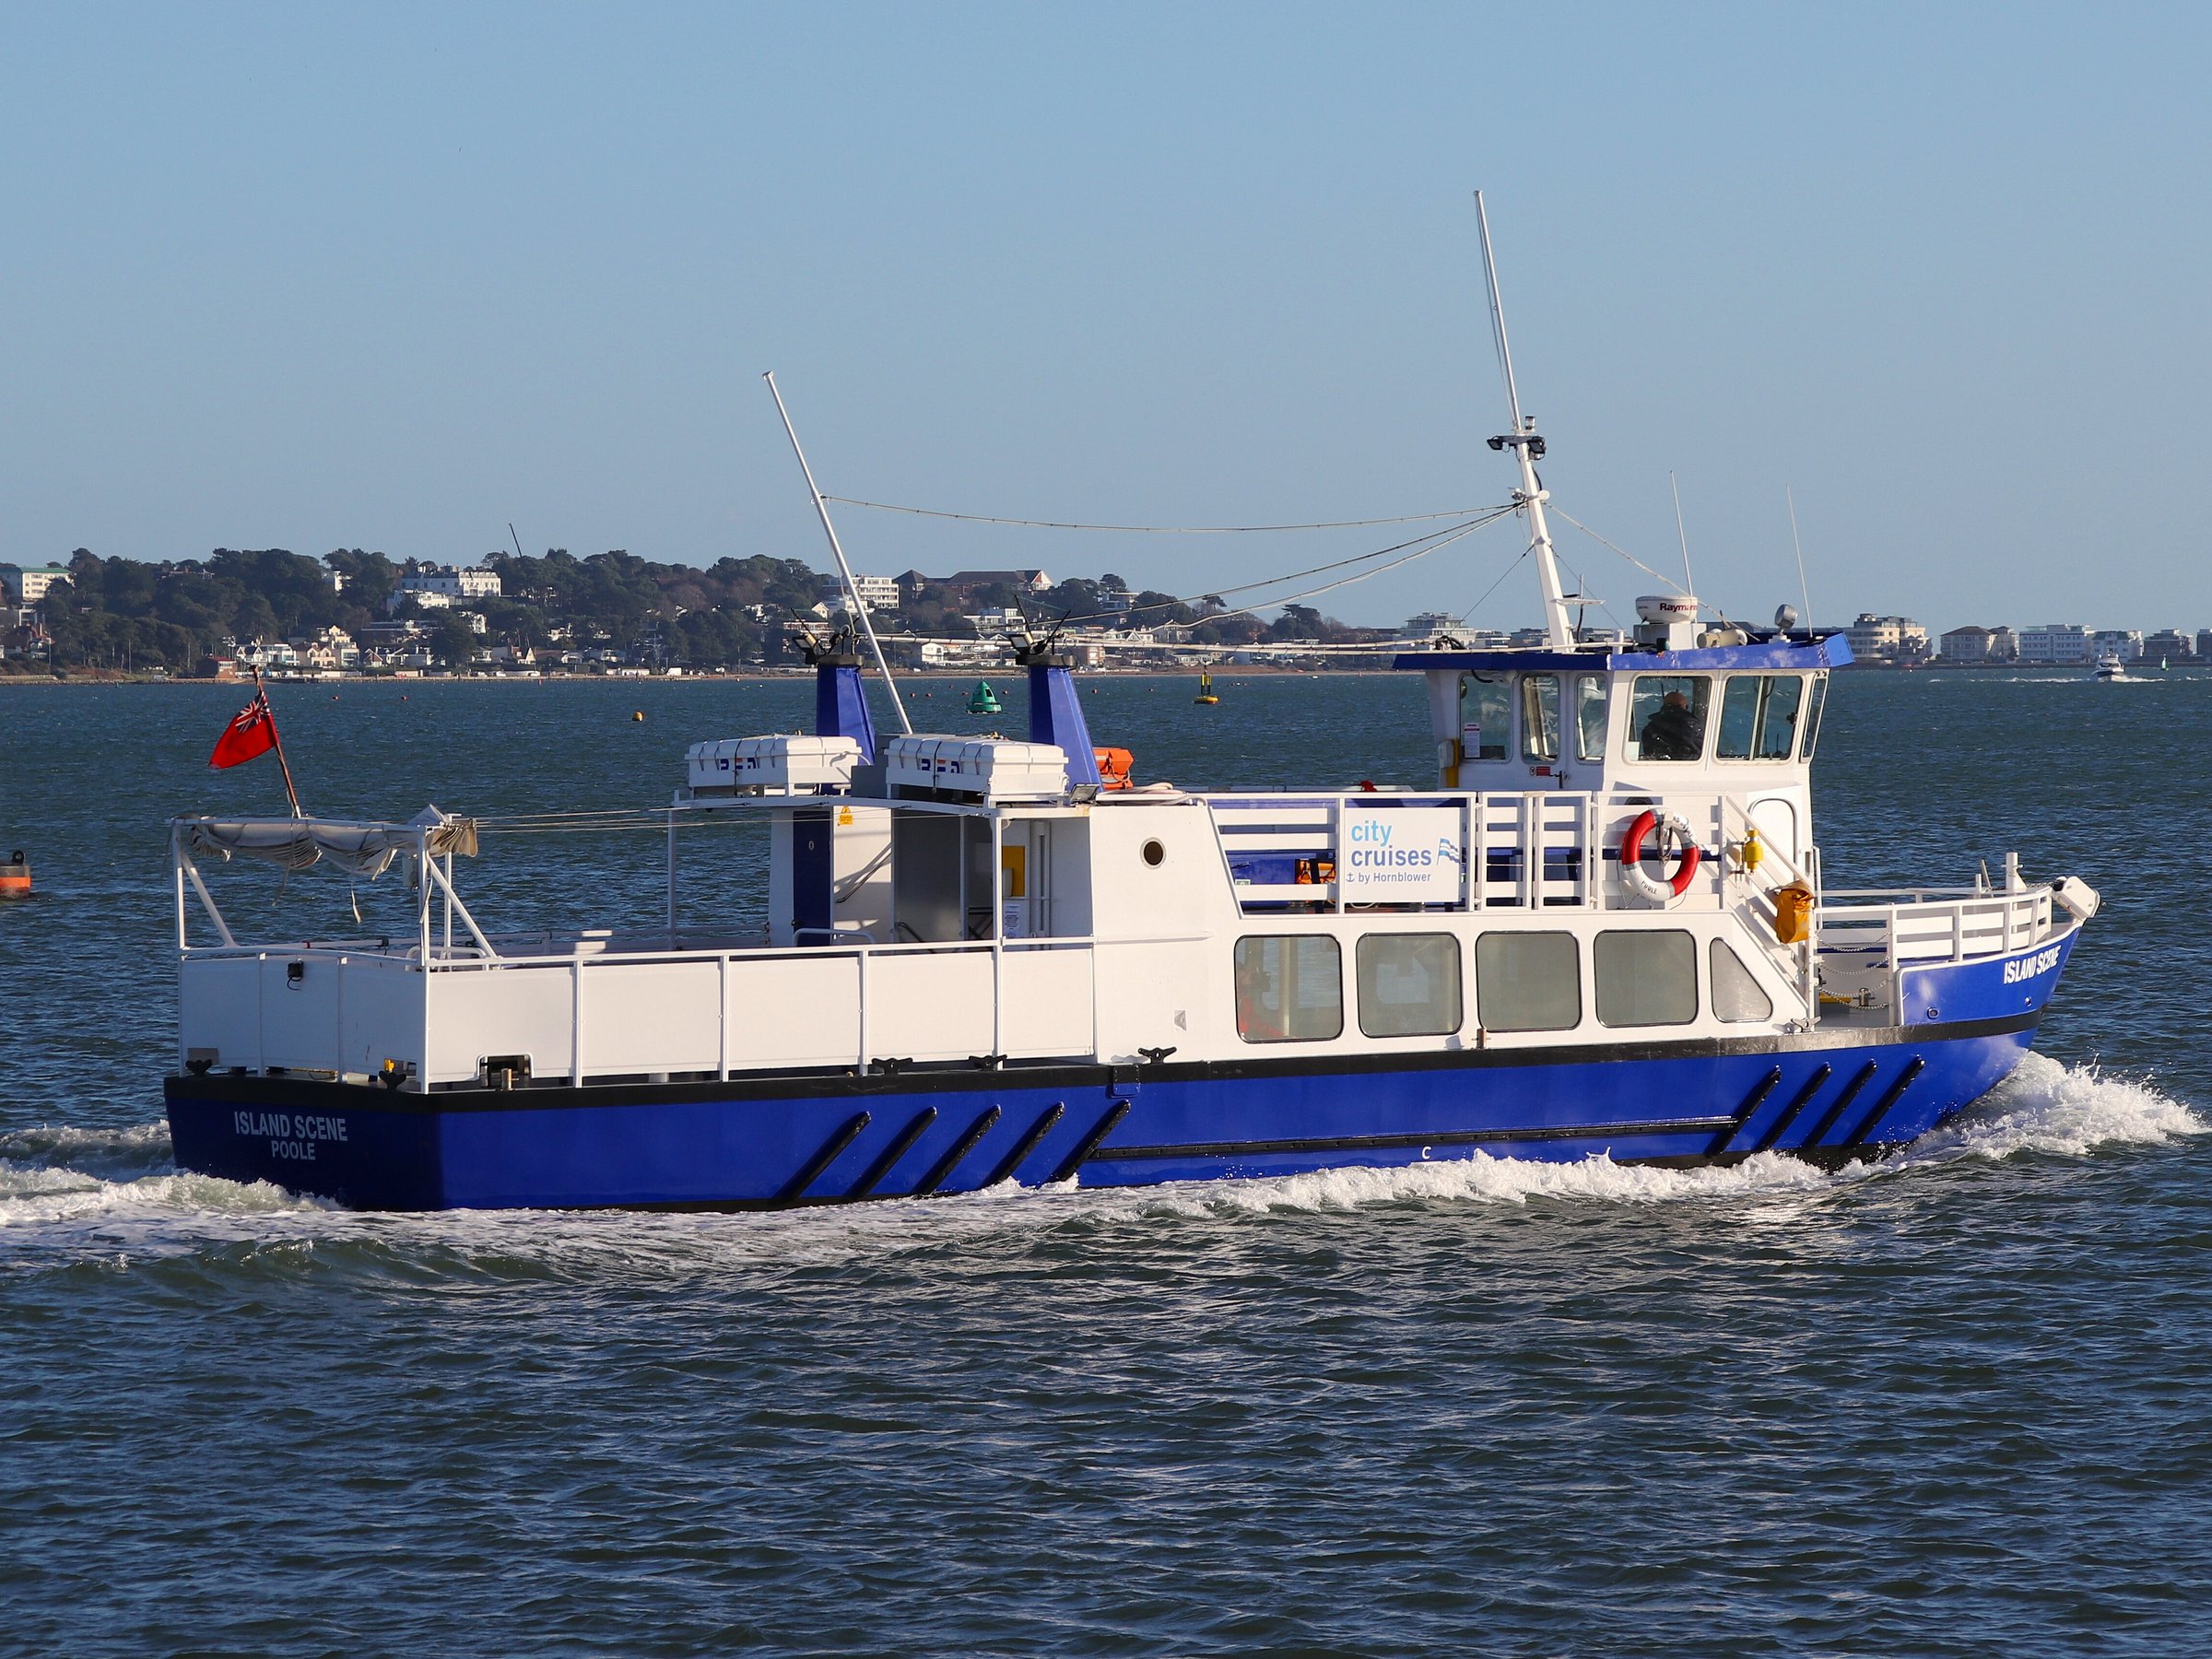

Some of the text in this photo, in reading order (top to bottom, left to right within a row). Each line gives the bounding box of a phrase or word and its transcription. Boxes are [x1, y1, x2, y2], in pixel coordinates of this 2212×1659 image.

[1350, 819, 1393, 847] city
[1350, 845, 1432, 866] cruises
[1358, 872, 1430, 884] by Hornblower
[2003, 945, 2062, 984] ISLAND SCENE
[234, 1111, 348, 1141] ISLAND SCENE
[271, 1140, 316, 1160] POOLE
